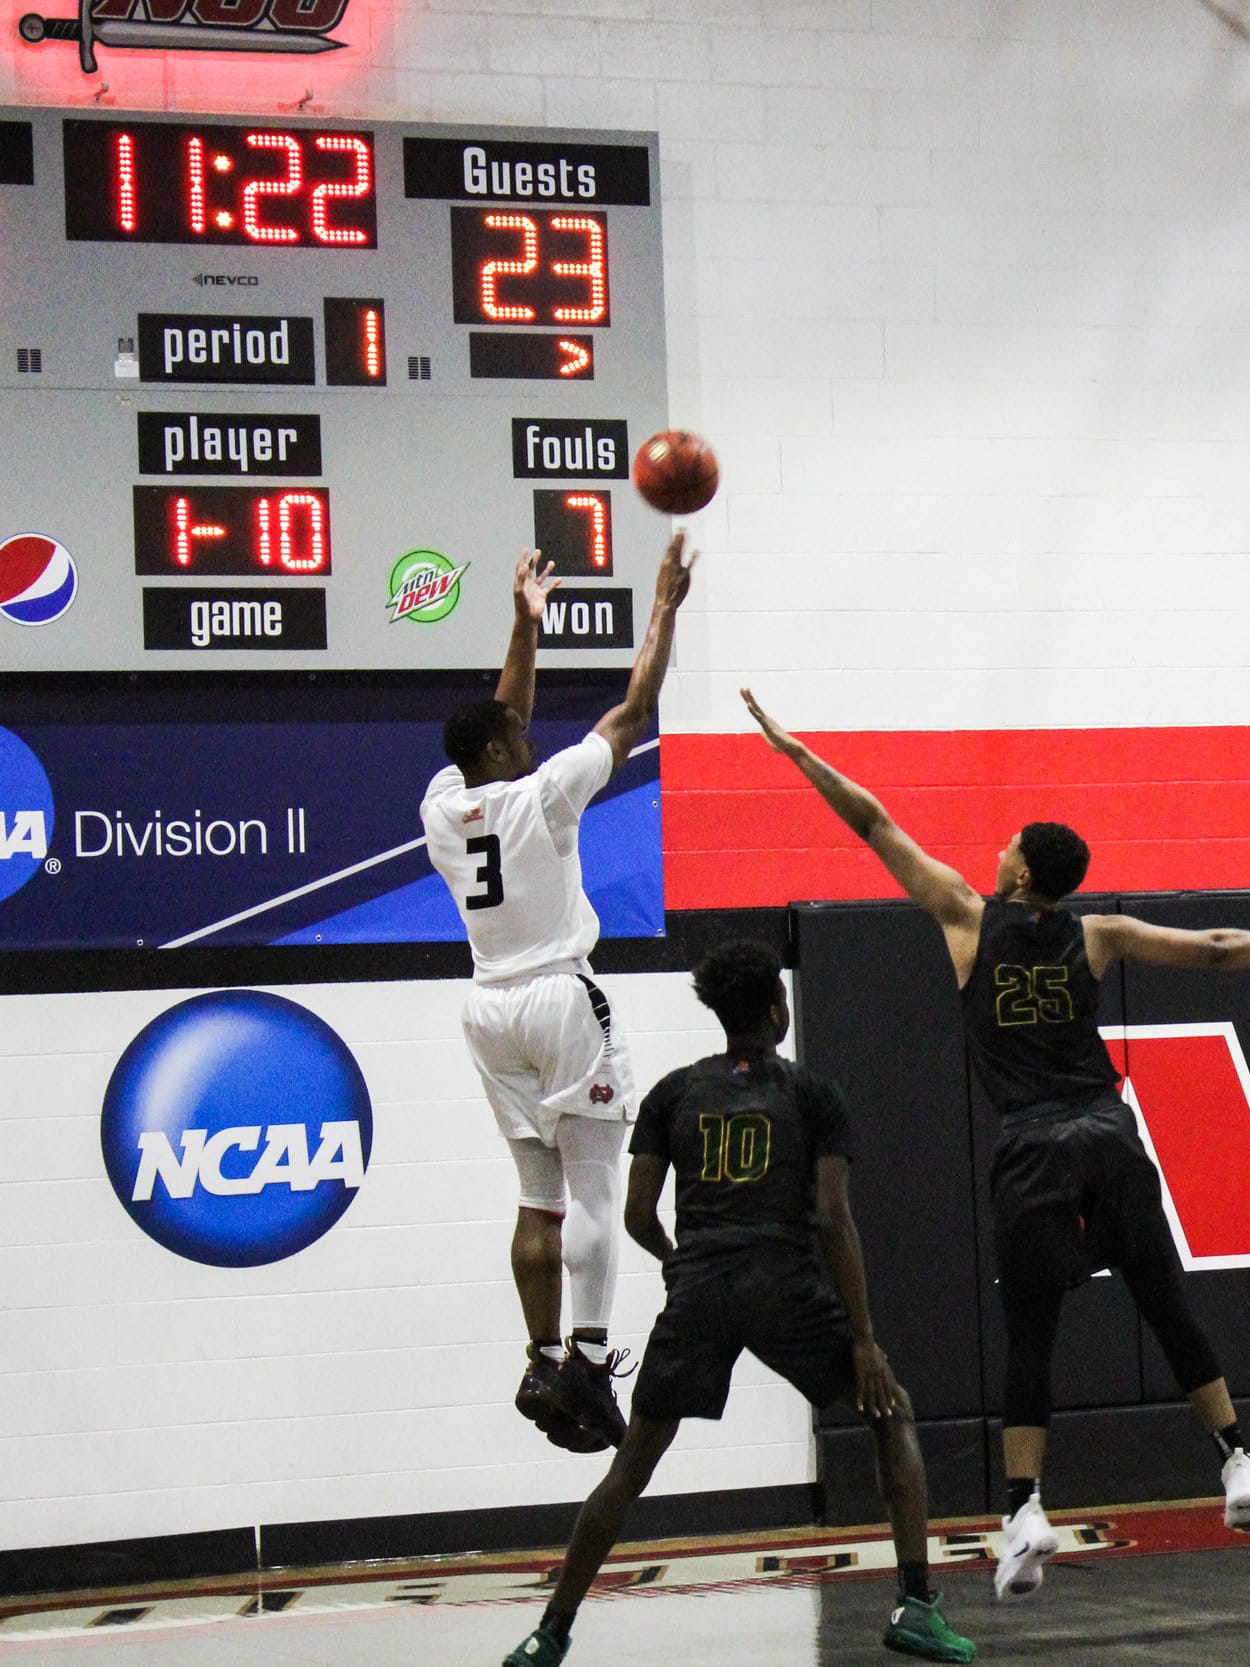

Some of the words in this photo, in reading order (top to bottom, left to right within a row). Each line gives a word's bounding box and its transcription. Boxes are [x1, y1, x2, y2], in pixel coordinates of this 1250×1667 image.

[119, 133, 369, 243] 11:22
[463, 146, 596, 198] Guests
[482, 214, 605, 321] 23
[163, 319, 289, 374] period
[364, 309, 379, 377] 1
[164, 416, 298, 471] player
[525, 426, 617, 471] fouls
[565, 496, 606, 567] 7
[190, 600, 283, 646] game
[541, 601, 614, 635] won
[75, 809, 267, 858] Division
[466, 833, 504, 910] 3
[994, 963, 1074, 1026] 25
[132, 1120, 366, 1201] NCAA
[699, 1113, 771, 1182] 10
